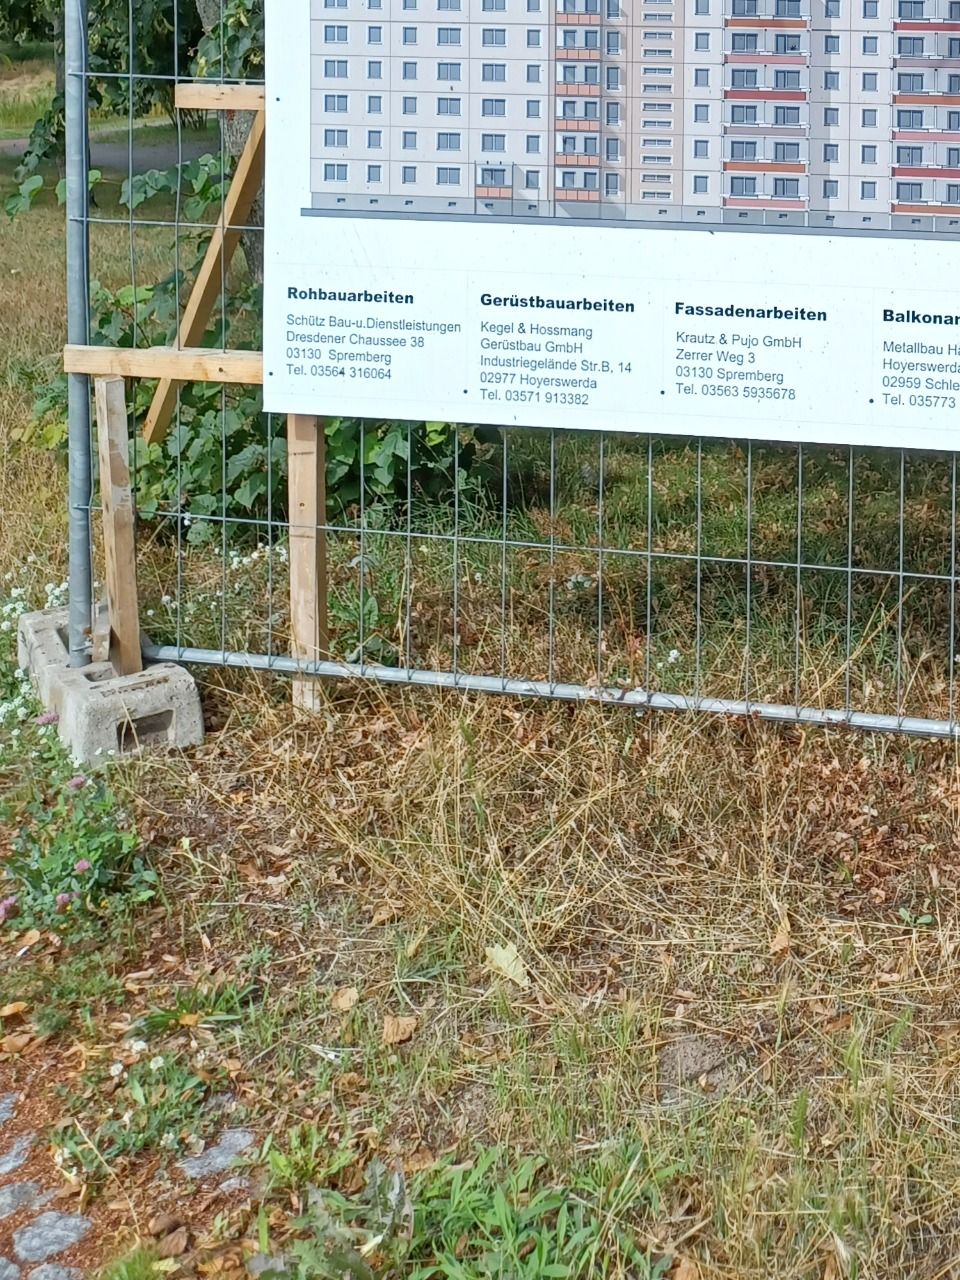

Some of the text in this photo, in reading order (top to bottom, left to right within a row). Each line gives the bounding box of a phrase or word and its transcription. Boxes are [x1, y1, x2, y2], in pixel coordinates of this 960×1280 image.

[287, 287, 415, 304] Rohbauarbeiten
[480, 293, 635, 313] Gerüstbauarbeiten
[675, 302, 828, 322] Fassadenarbeiten
[286, 314, 461, 334] Schütz Bau-u.Dienstleistungen
[480, 321, 593, 340] Kegel & Hossmang
[286, 331, 425, 348] Dresdener Chaussee 38
[480, 338, 583, 354] Gerüstbau GmbH
[676, 331, 802, 349] Krautz & Pujo GmbH
[883, 341, 944, 355] Metallbau
[286, 347, 392, 365] 03130 Spremberg
[480, 355, 632, 374] Industriegelände Str.B, 14
[675, 348, 756, 366] Zerrer Weg 3
[286, 364, 392, 380] Tel. 03564 316064
[480, 372, 597, 389] 02977 Hoyerswerda
[675, 365, 784, 384] 03130 Spremberg
[675, 383, 796, 400] Tel. 03563 5935678
[882, 376, 921, 390] 02959
[480, 388, 589, 405] Tel. 03571 913382
[882, 393, 905, 406] Tel.
[908, 394, 956, 409] 035773
